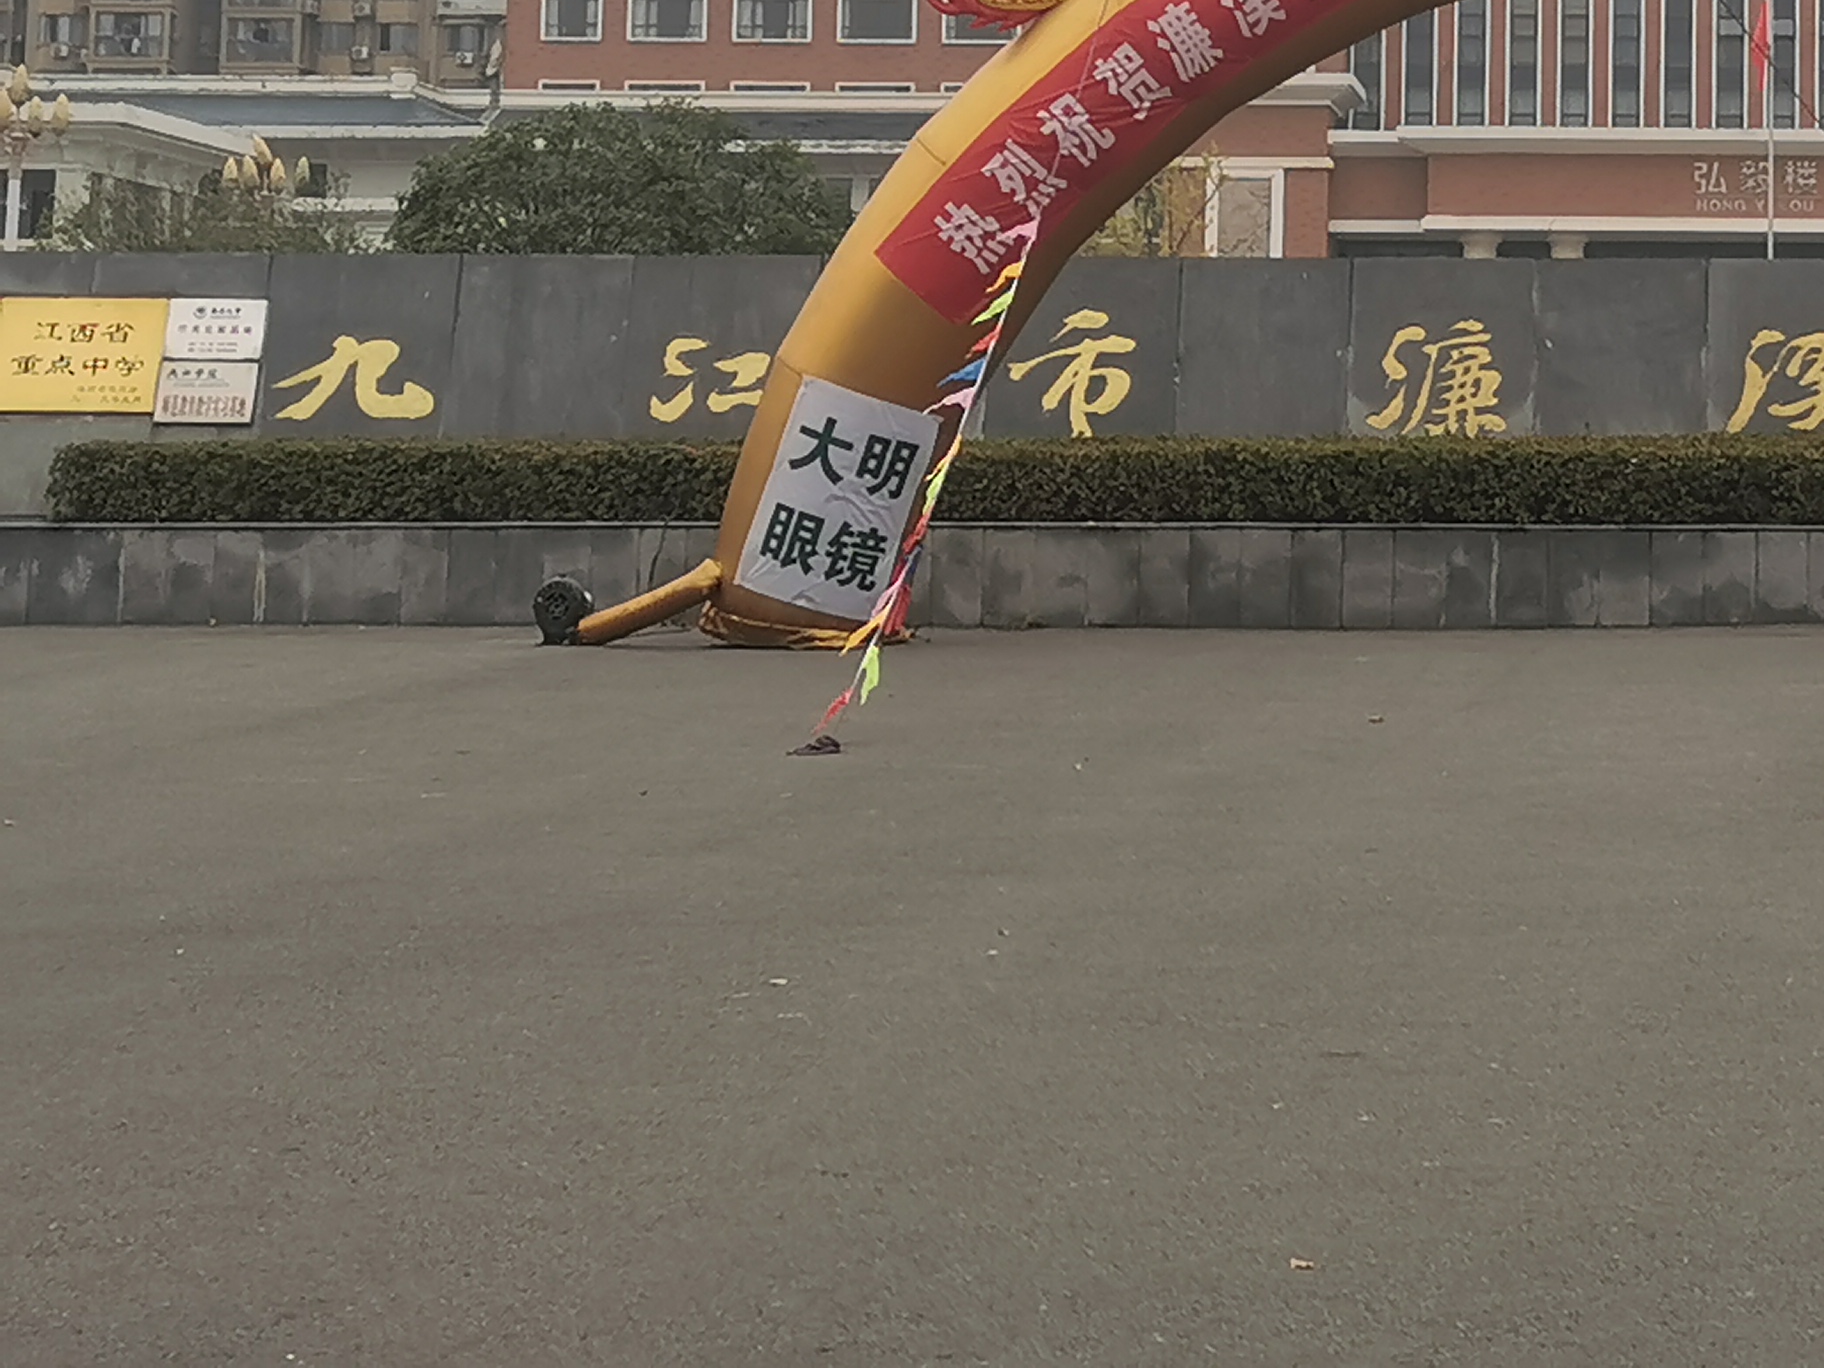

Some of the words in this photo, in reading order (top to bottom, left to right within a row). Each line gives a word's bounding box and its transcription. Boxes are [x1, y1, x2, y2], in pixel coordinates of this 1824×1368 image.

[33, 322, 135, 343] 江西省
[11, 354, 145, 377] 重点中学
[788, 416, 920, 500] 大明
[759, 502, 888, 594] 眼镜
